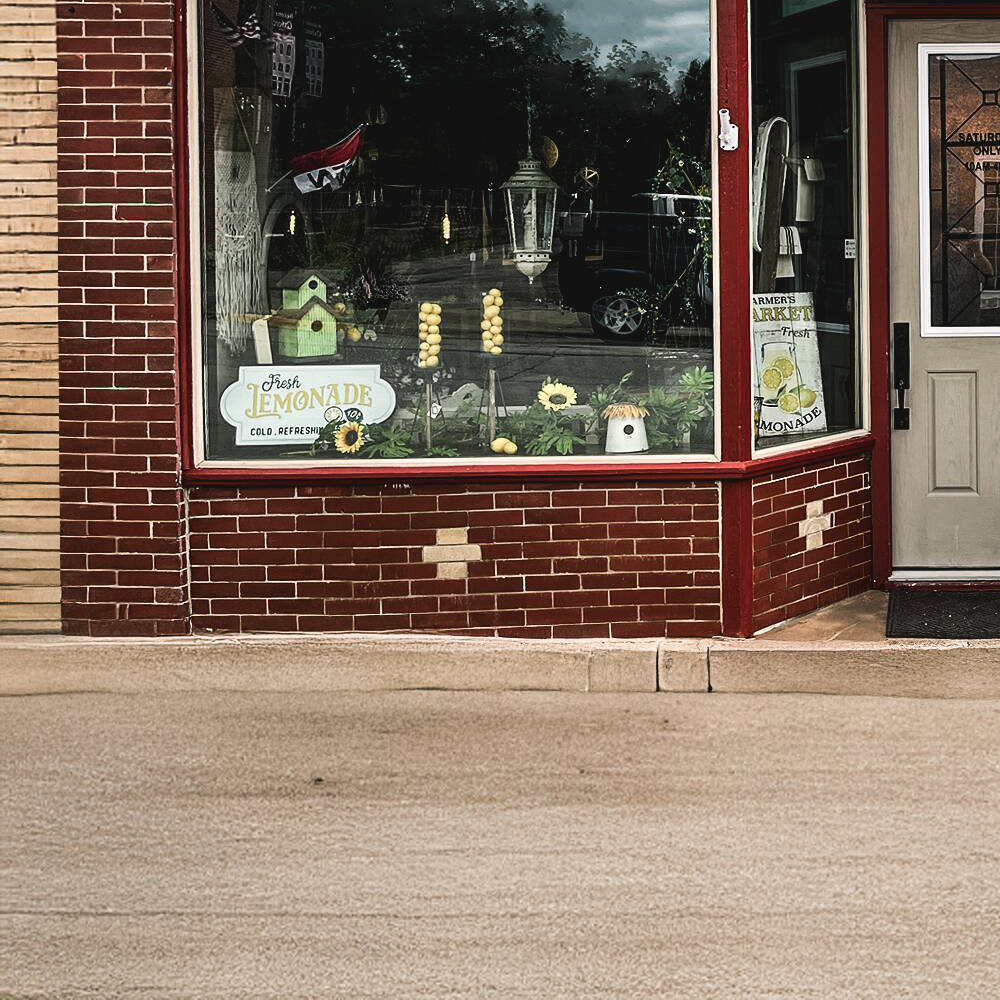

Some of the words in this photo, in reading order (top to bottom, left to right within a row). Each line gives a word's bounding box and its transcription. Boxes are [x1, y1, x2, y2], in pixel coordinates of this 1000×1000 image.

[753, 296, 796, 305] ARMER'S
[753, 306, 812, 322] ARKET
[781, 326, 810, 338] Fresh
[262, 373, 302, 392] Fresh
[245, 383, 373, 418] LEMONADE
[759, 406, 822, 432] MONADE
[278, 426, 323, 436] REFRESHI
